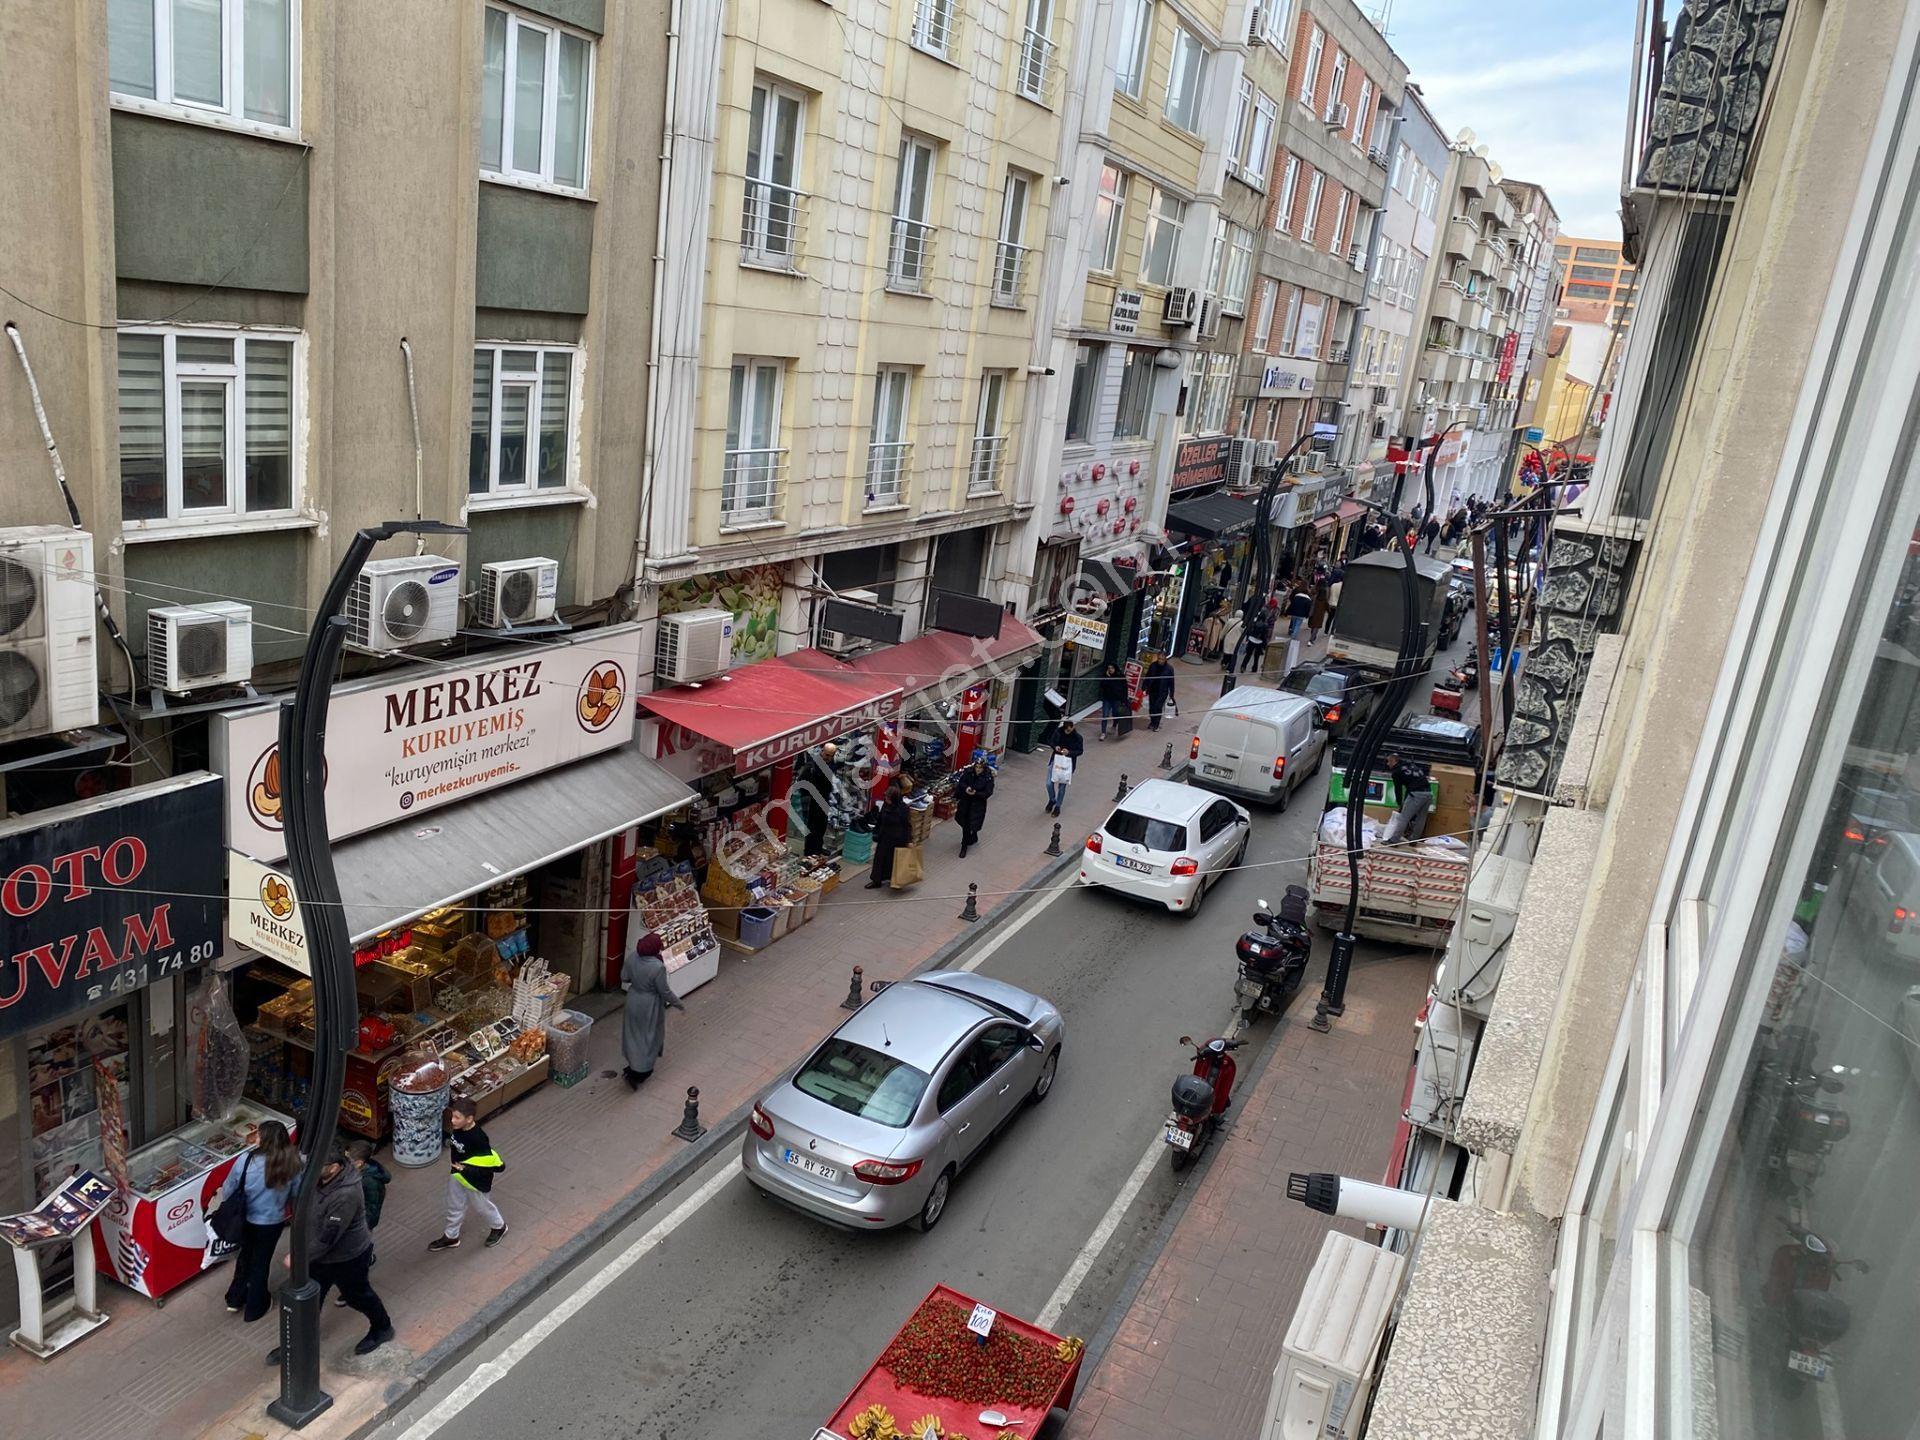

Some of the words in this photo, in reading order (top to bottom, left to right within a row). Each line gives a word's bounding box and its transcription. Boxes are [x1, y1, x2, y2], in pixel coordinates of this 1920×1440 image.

[1179, 443, 1218, 467] ÖZELLER
[1068, 615, 1106, 632] BERBER
[384, 661, 542, 733] MERKEZ
[402, 707, 525, 759] KURUYEMİŞ
[385, 749, 477, 787] “kuruyemişin
[482, 729, 536, 760] merkezi”
[1, 836, 147, 917] OTO
[251, 912, 304, 949] MERKEZ
[110, 963, 148, 993] 431
[158, 951, 183, 976] 74
[190, 940, 214, 965] 80
[789, 1152, 800, 1165] 55
[804, 1159, 815, 1171] RY
[820, 1166, 835, 1179] 227
[167, 1213, 195, 1232] ALGIDA
[970, 1313, 989, 1329] 100
